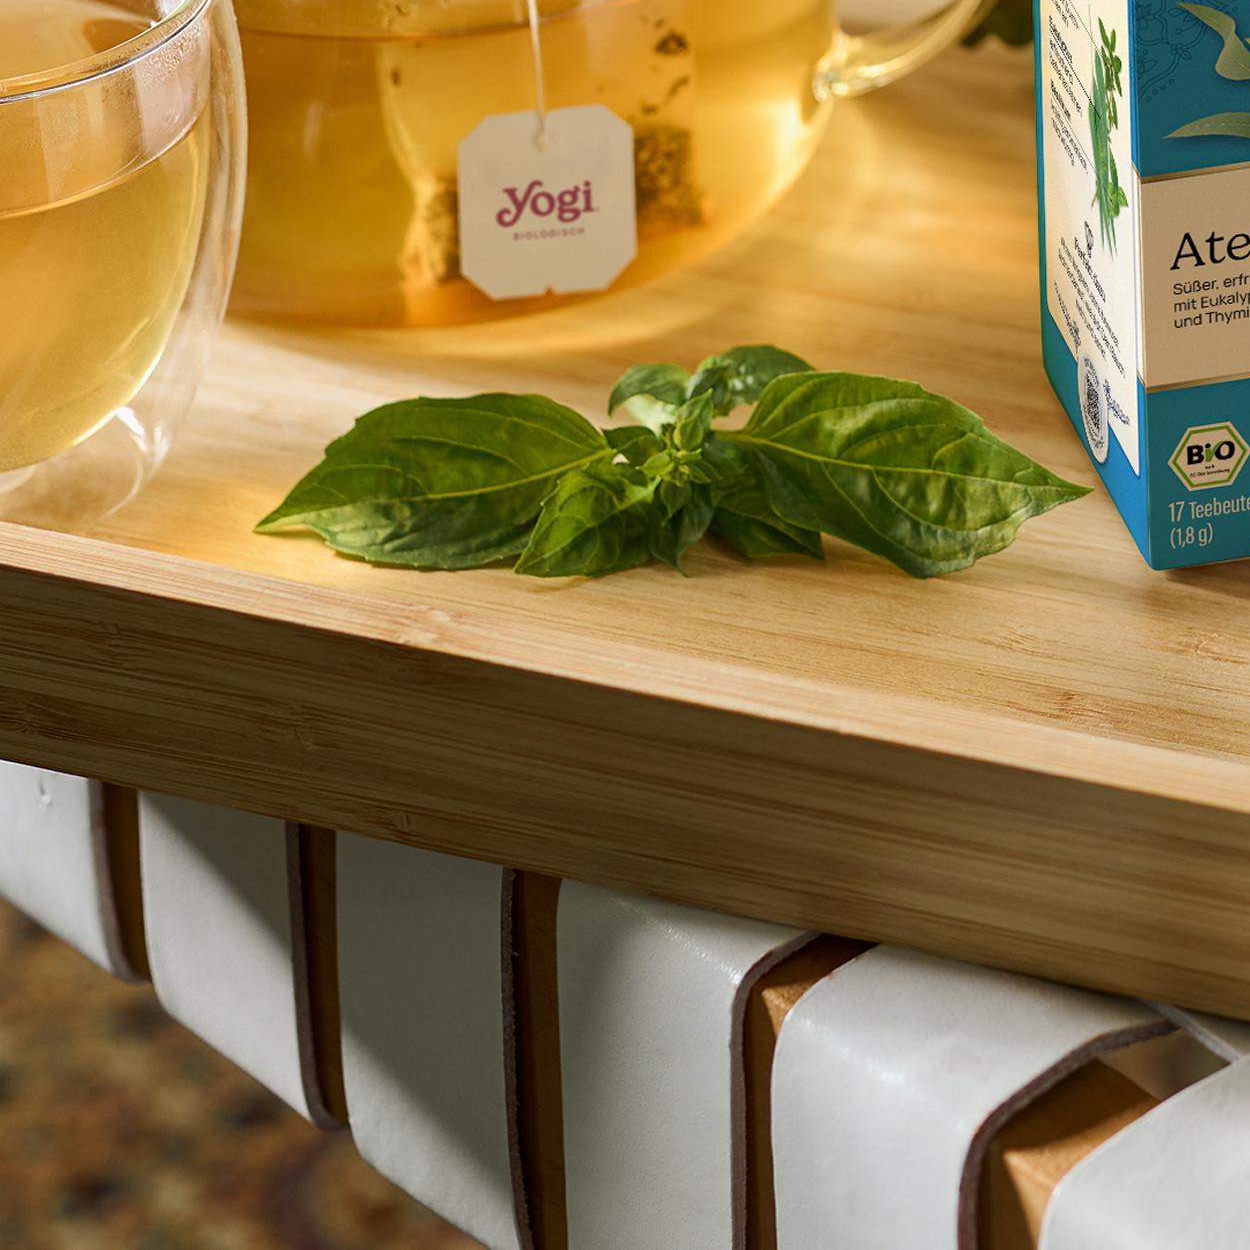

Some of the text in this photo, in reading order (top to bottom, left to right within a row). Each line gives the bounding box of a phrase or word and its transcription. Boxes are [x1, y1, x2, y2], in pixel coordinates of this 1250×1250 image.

[512, 227, 586, 242] BIOLOGISCH
[1173, 298, 1198, 313] mit
[1173, 314, 1203, 329] und
[1168, 500, 1185, 523] 17
[1170, 522, 1213, 549] (1,8 g)
